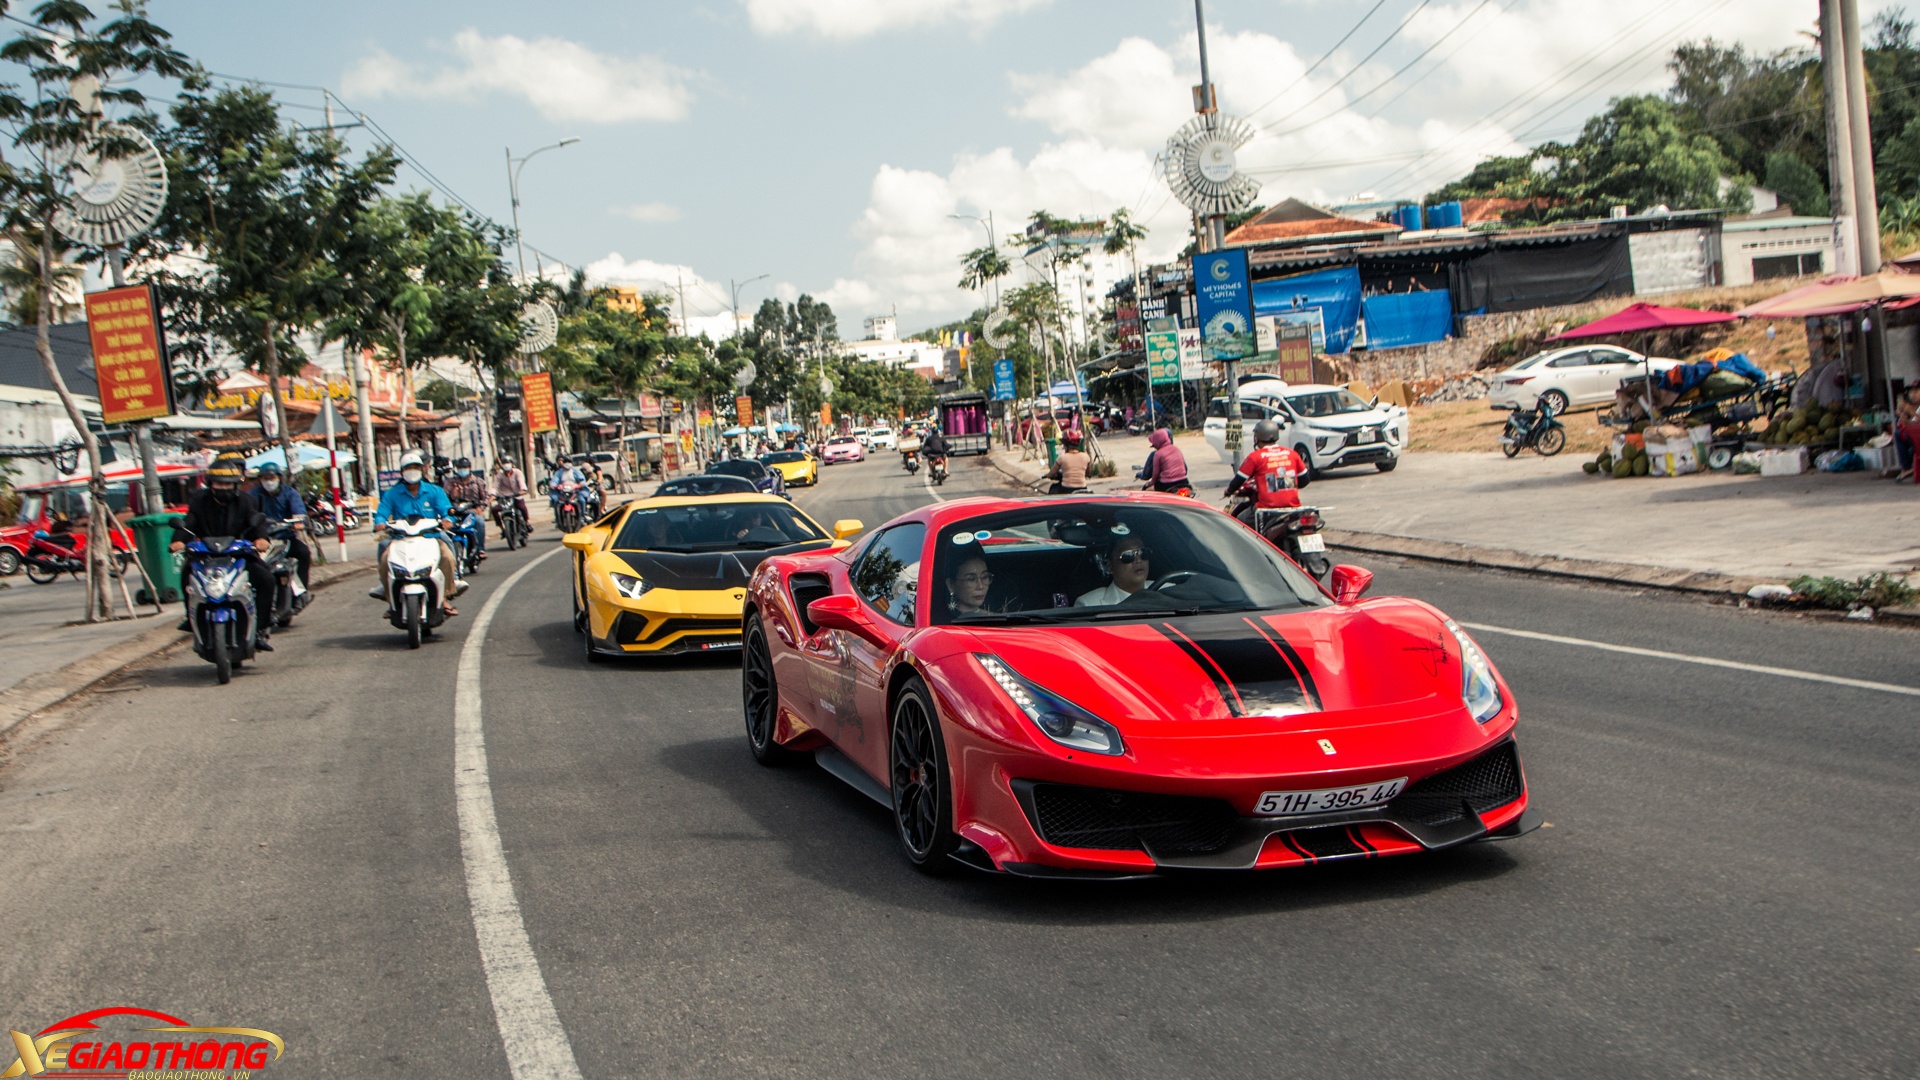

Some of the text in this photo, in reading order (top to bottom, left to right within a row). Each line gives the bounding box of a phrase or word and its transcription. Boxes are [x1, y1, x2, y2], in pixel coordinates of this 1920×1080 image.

[1203, 282, 1242, 293] MEYHOMES
[1209, 290, 1236, 299] CAPITAL
[1142, 309, 1165, 320] CANH
[1261, 782, 1398, 813] 51H-395.44
